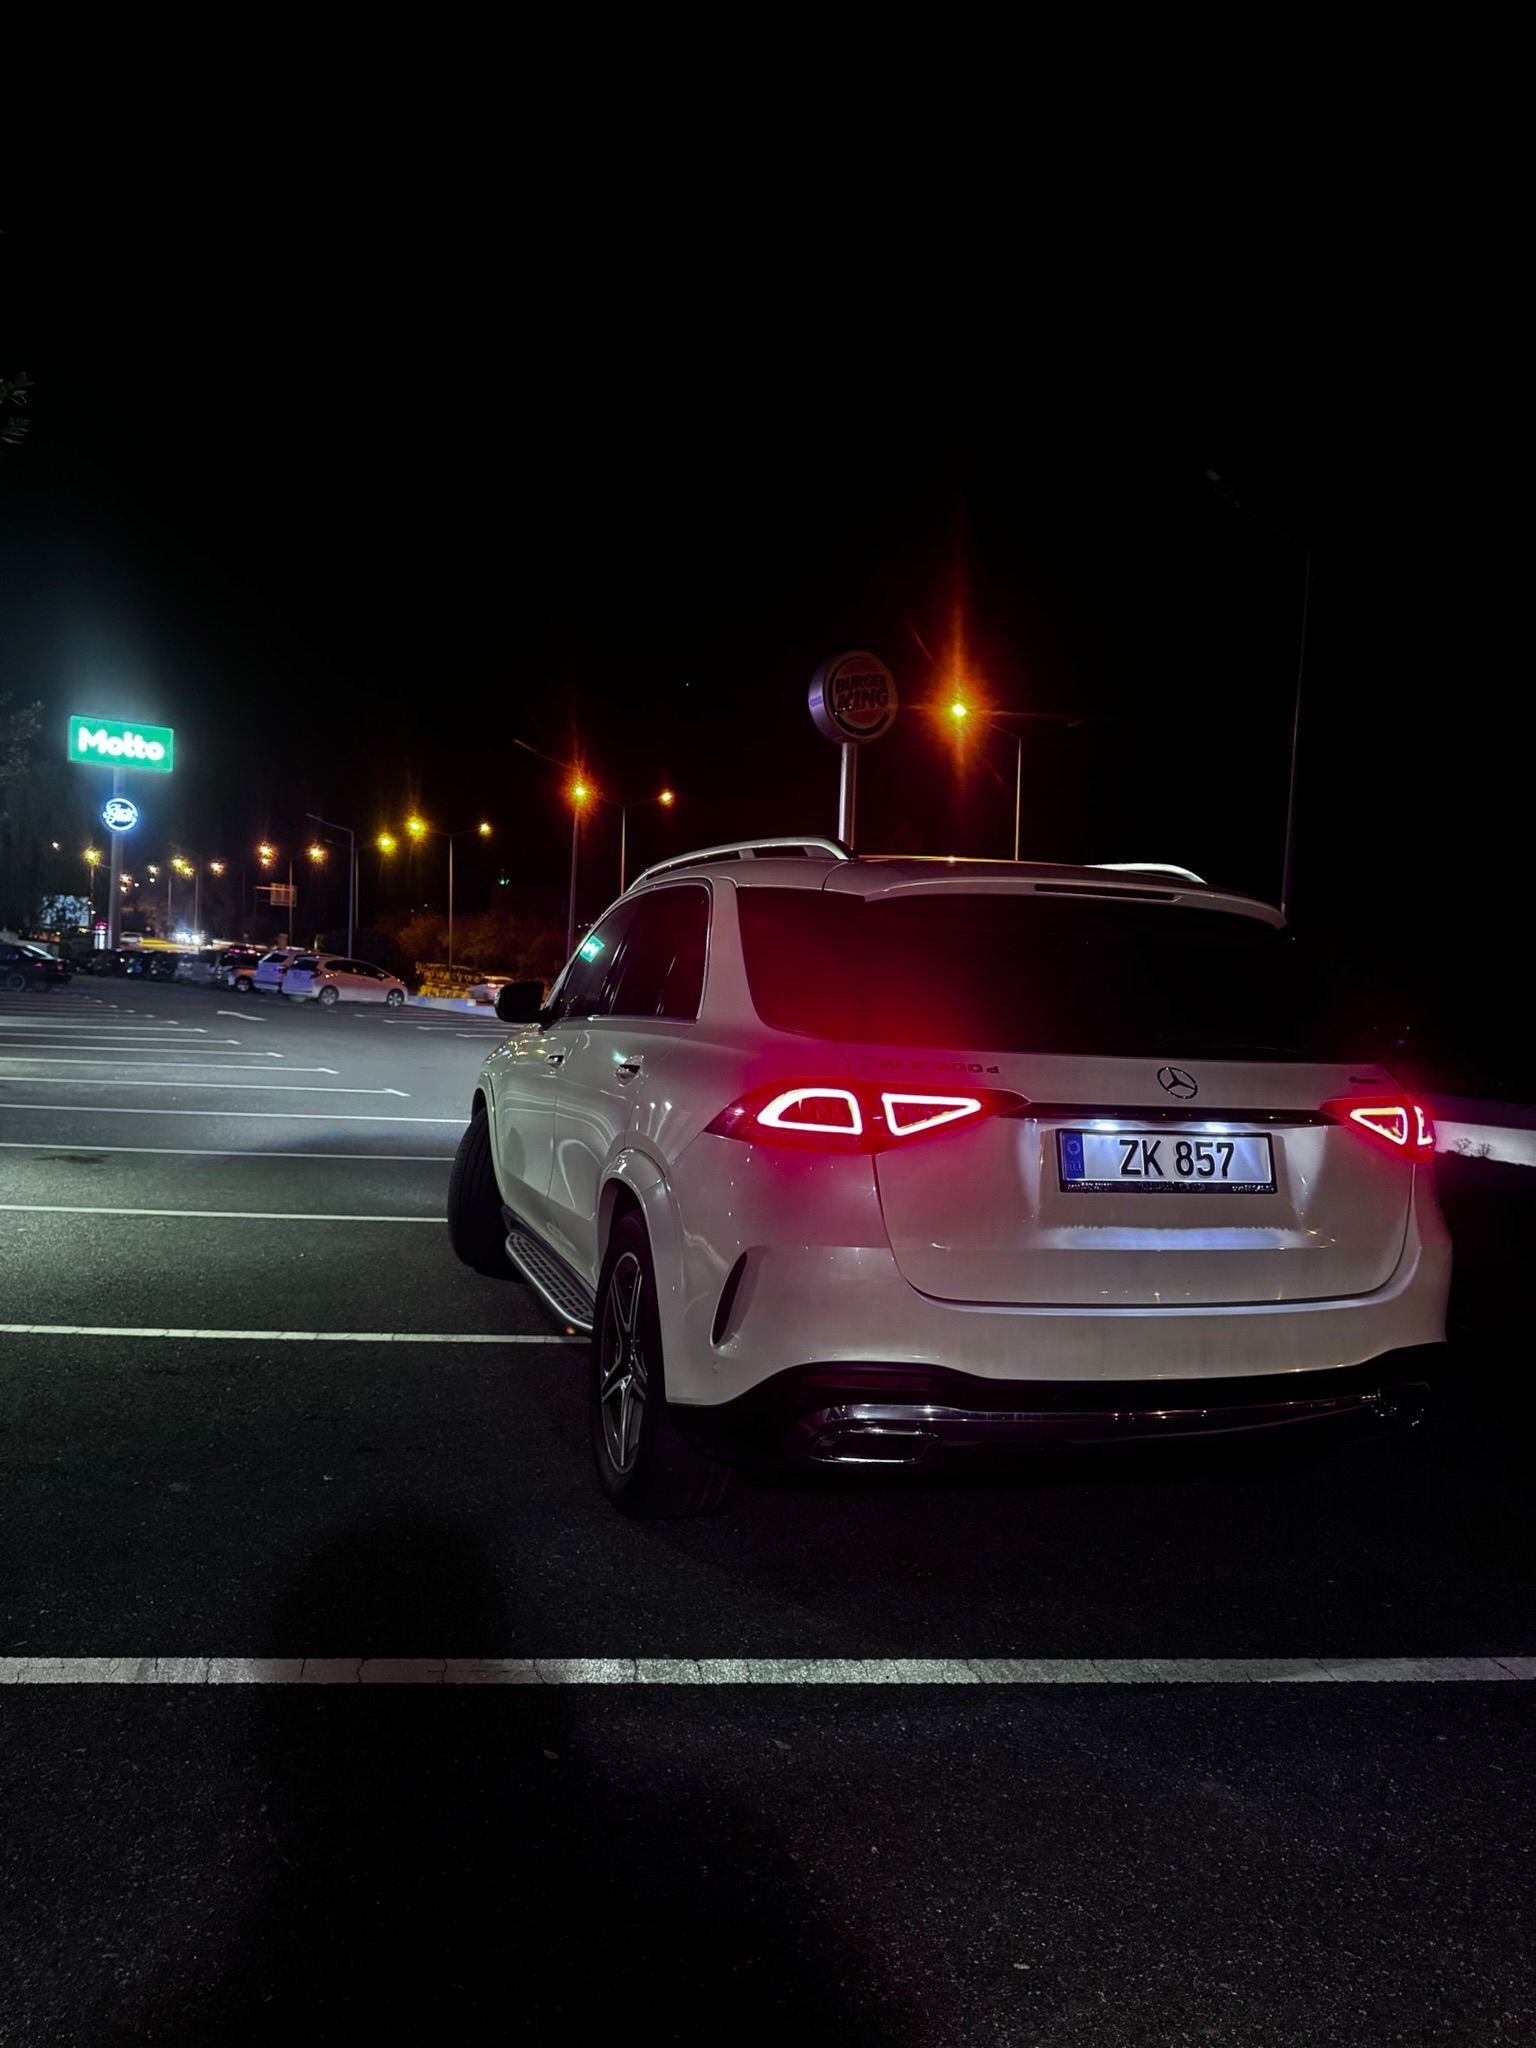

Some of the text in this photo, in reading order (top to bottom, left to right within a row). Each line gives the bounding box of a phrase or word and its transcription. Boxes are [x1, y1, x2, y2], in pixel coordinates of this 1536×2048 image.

[836, 674, 888, 694] BURGER
[837, 687, 889, 710] KING
[78, 726, 165, 761] Molto
[1119, 1139, 1234, 1177] ZK 857
